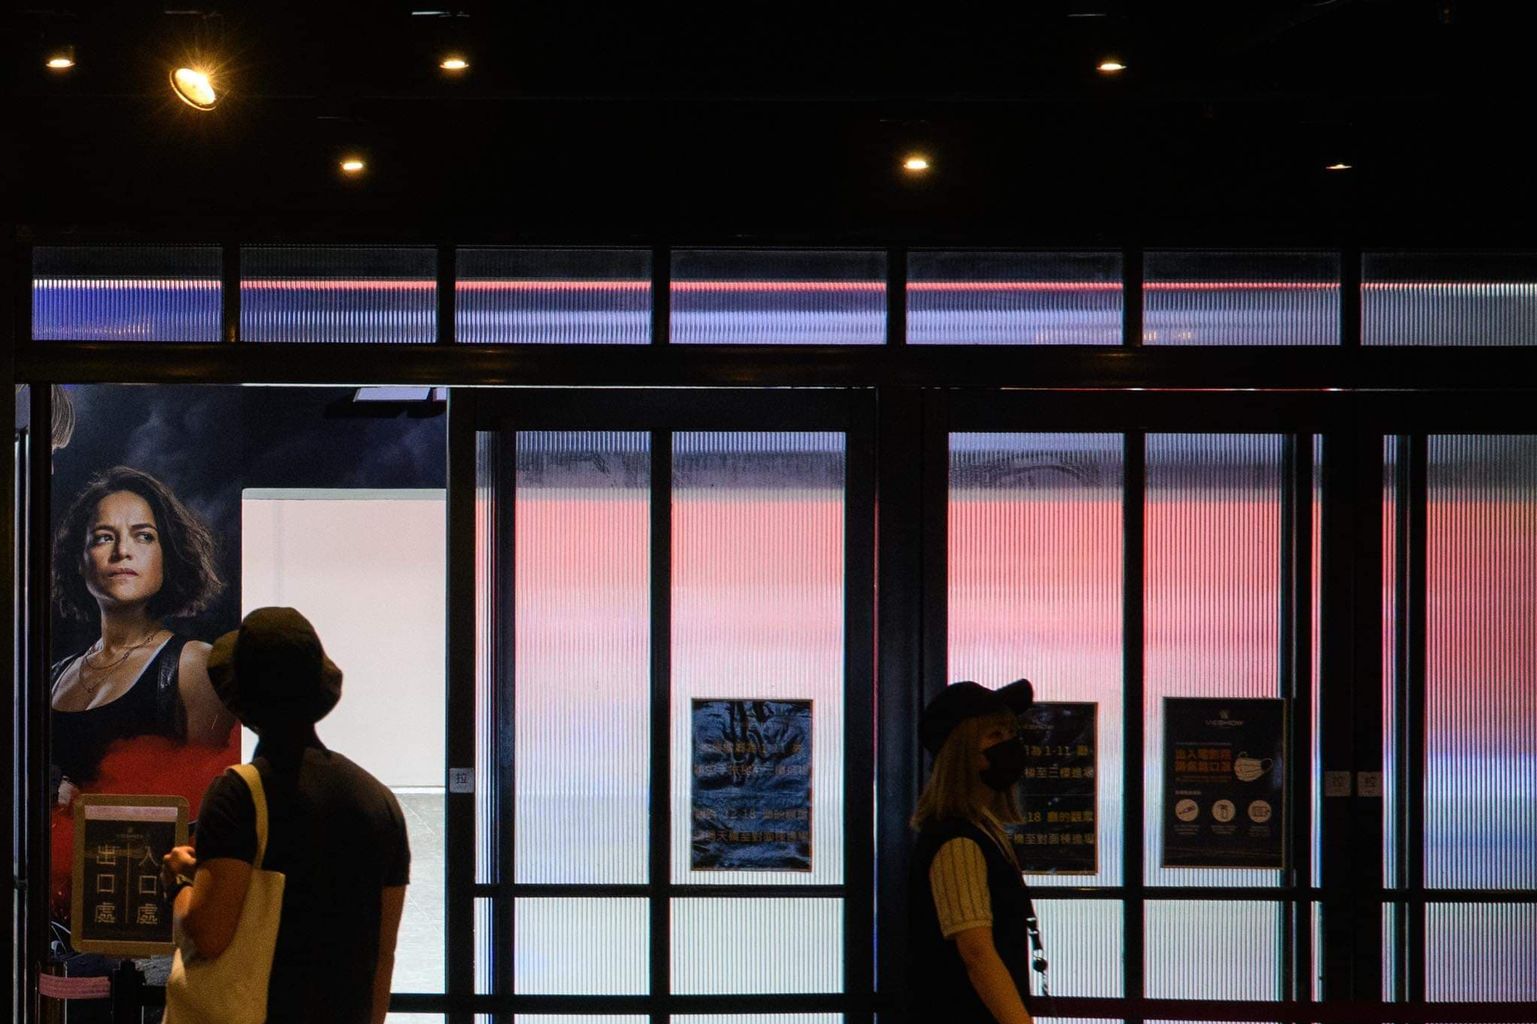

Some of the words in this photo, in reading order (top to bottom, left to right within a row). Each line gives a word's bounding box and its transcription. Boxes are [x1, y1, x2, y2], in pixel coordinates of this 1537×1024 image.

[95, 843, 117, 924] 出口處
[136, 845, 160, 926] 入口處
